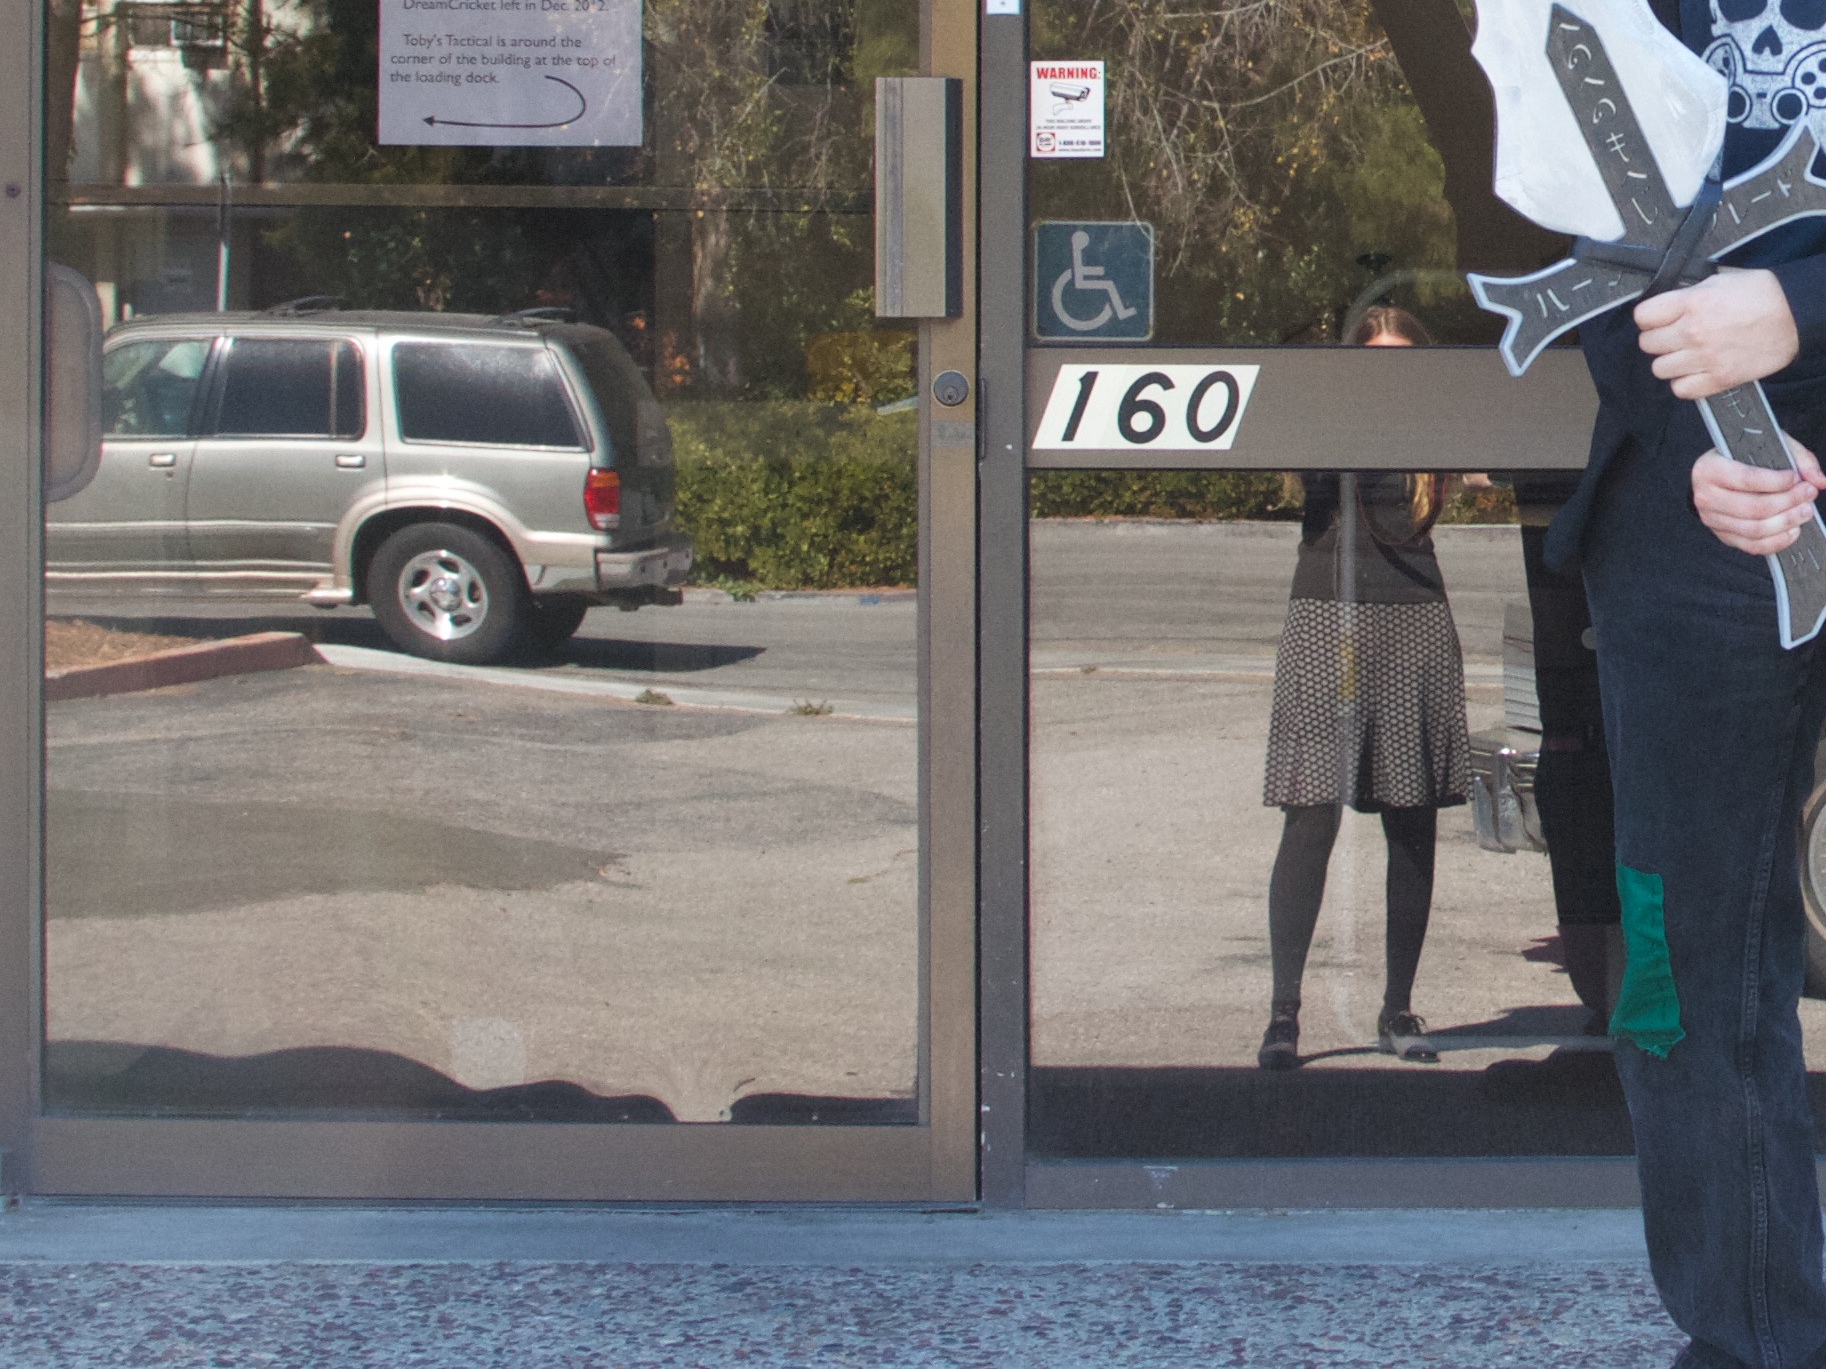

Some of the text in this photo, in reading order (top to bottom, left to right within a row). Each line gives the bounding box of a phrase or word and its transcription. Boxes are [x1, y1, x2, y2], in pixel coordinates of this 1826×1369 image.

[525, 0, 537, 11] in
[403, 33, 582, 49] Toby's Tactical is around the
[390, 52, 617, 69] corner of the building at the top of
[390, 71, 412, 82] the
[415, 70, 462, 87] loading
[1061, 370, 1240, 445] 160
